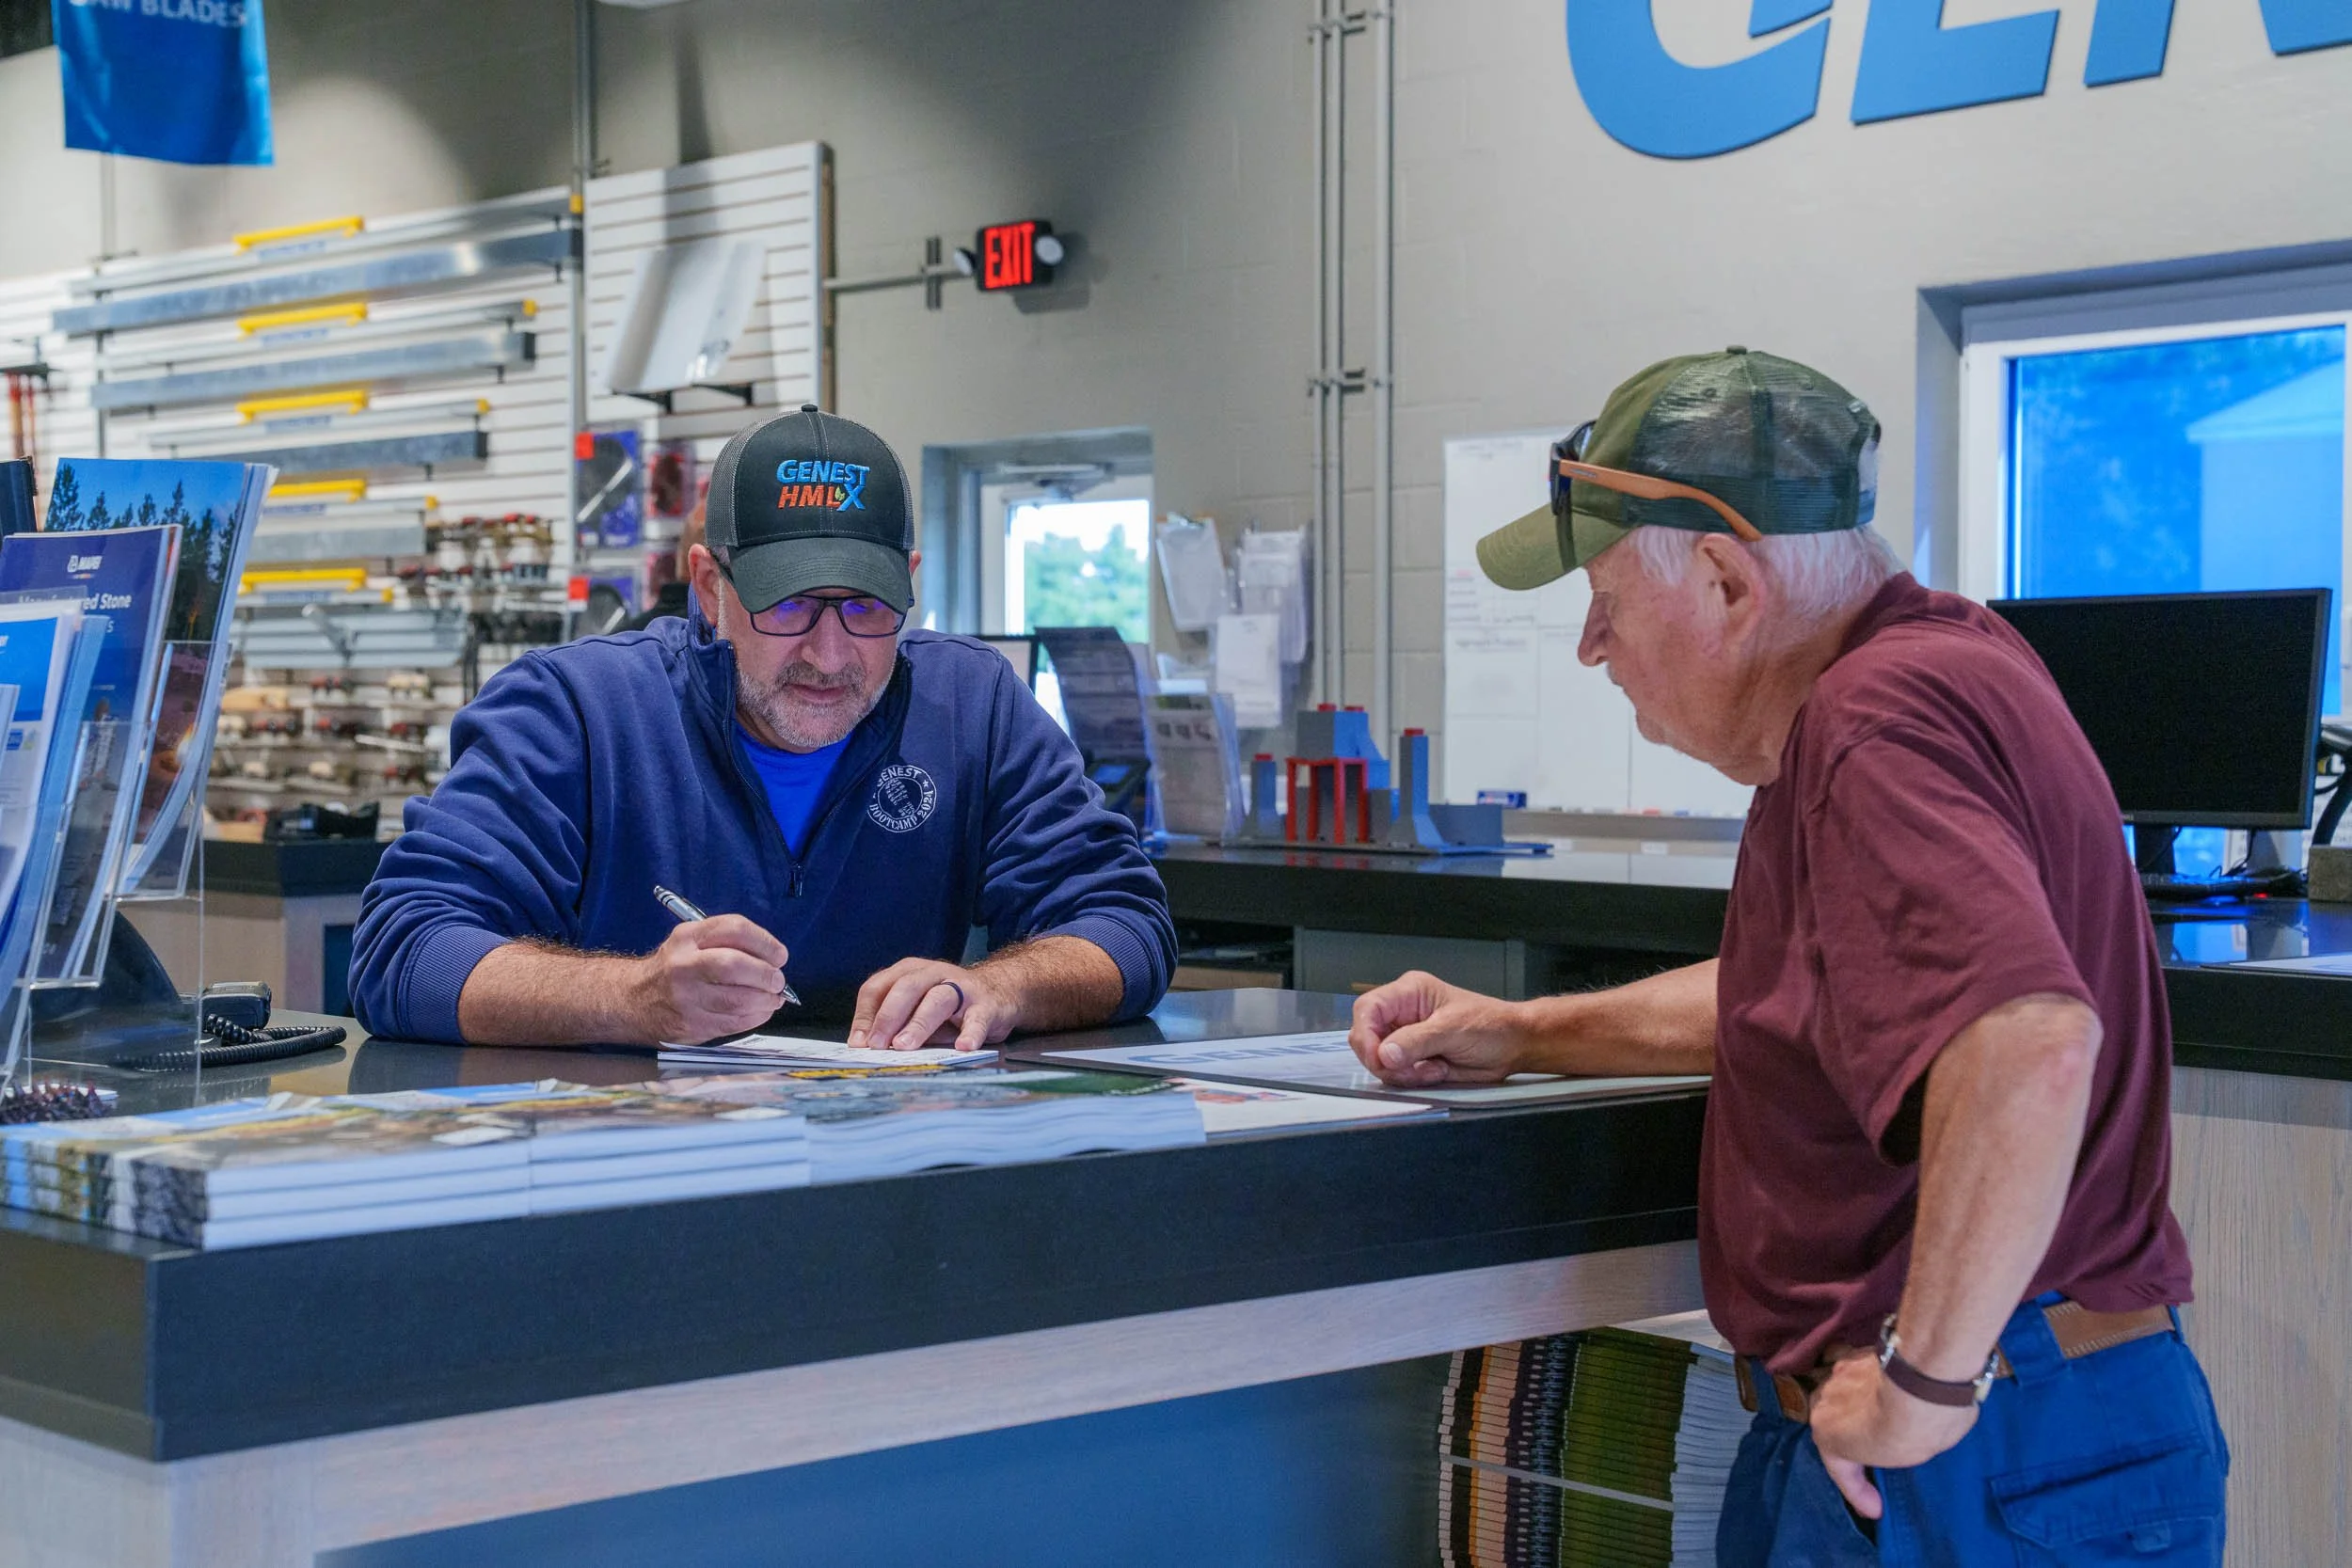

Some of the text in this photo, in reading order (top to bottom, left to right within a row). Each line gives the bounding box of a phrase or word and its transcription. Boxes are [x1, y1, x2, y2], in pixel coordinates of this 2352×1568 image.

[142, 0, 246, 27] BLADES
[985, 220, 1036, 290] EXIT
[776, 459, 870, 486] GENEST
[99, 593, 132, 610] Stone
